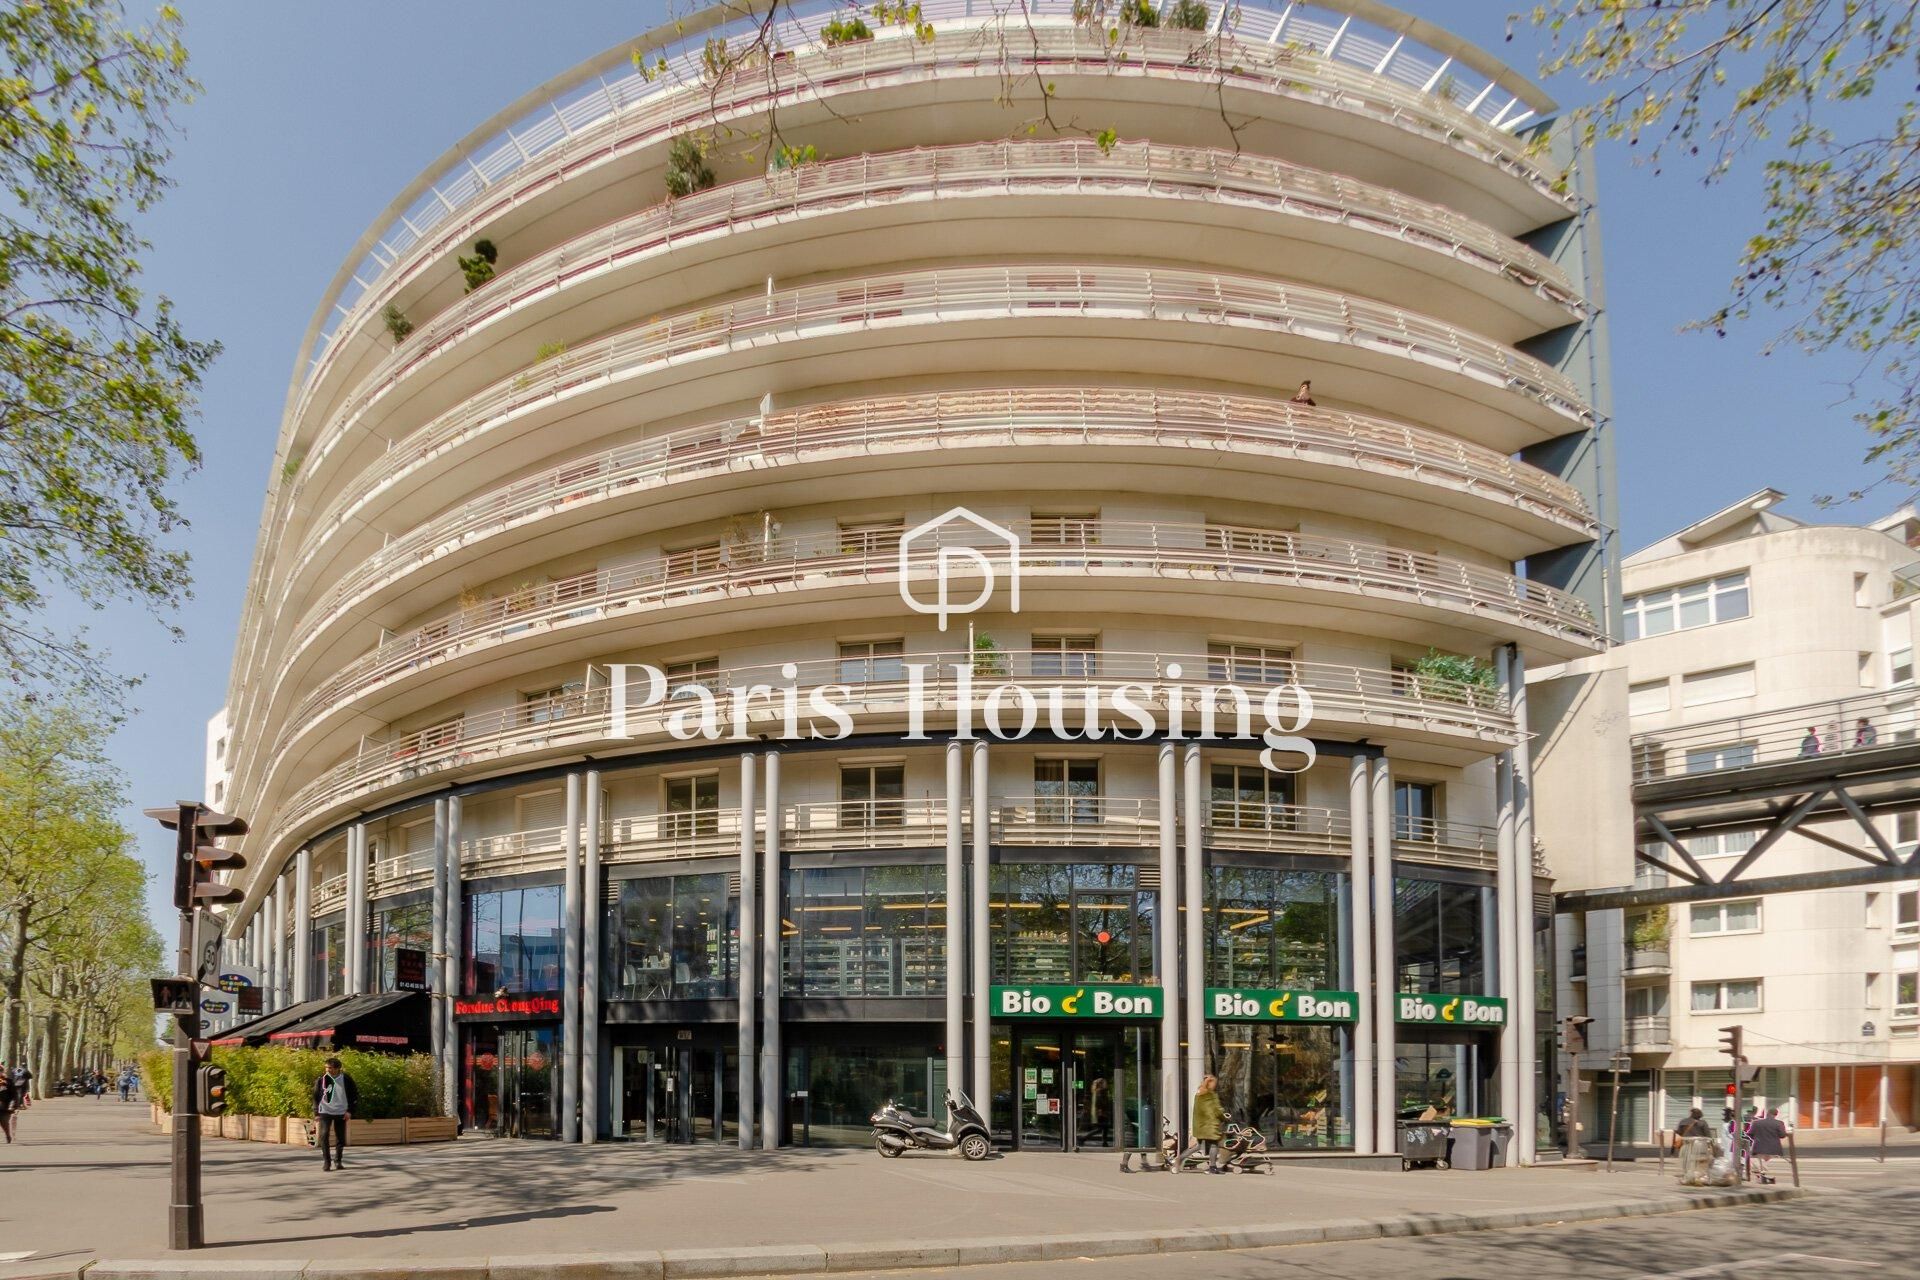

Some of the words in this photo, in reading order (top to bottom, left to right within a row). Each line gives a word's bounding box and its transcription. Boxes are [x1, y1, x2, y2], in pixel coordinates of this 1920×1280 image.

[1002, 990, 1051, 1014] Bio
[1094, 991, 1153, 1014] Bon
[1215, 993, 1260, 1017] Bio
[1298, 995, 1351, 1018] Bon
[1400, 998, 1436, 1020] Bio
[1463, 1000, 1503, 1022] Bon
